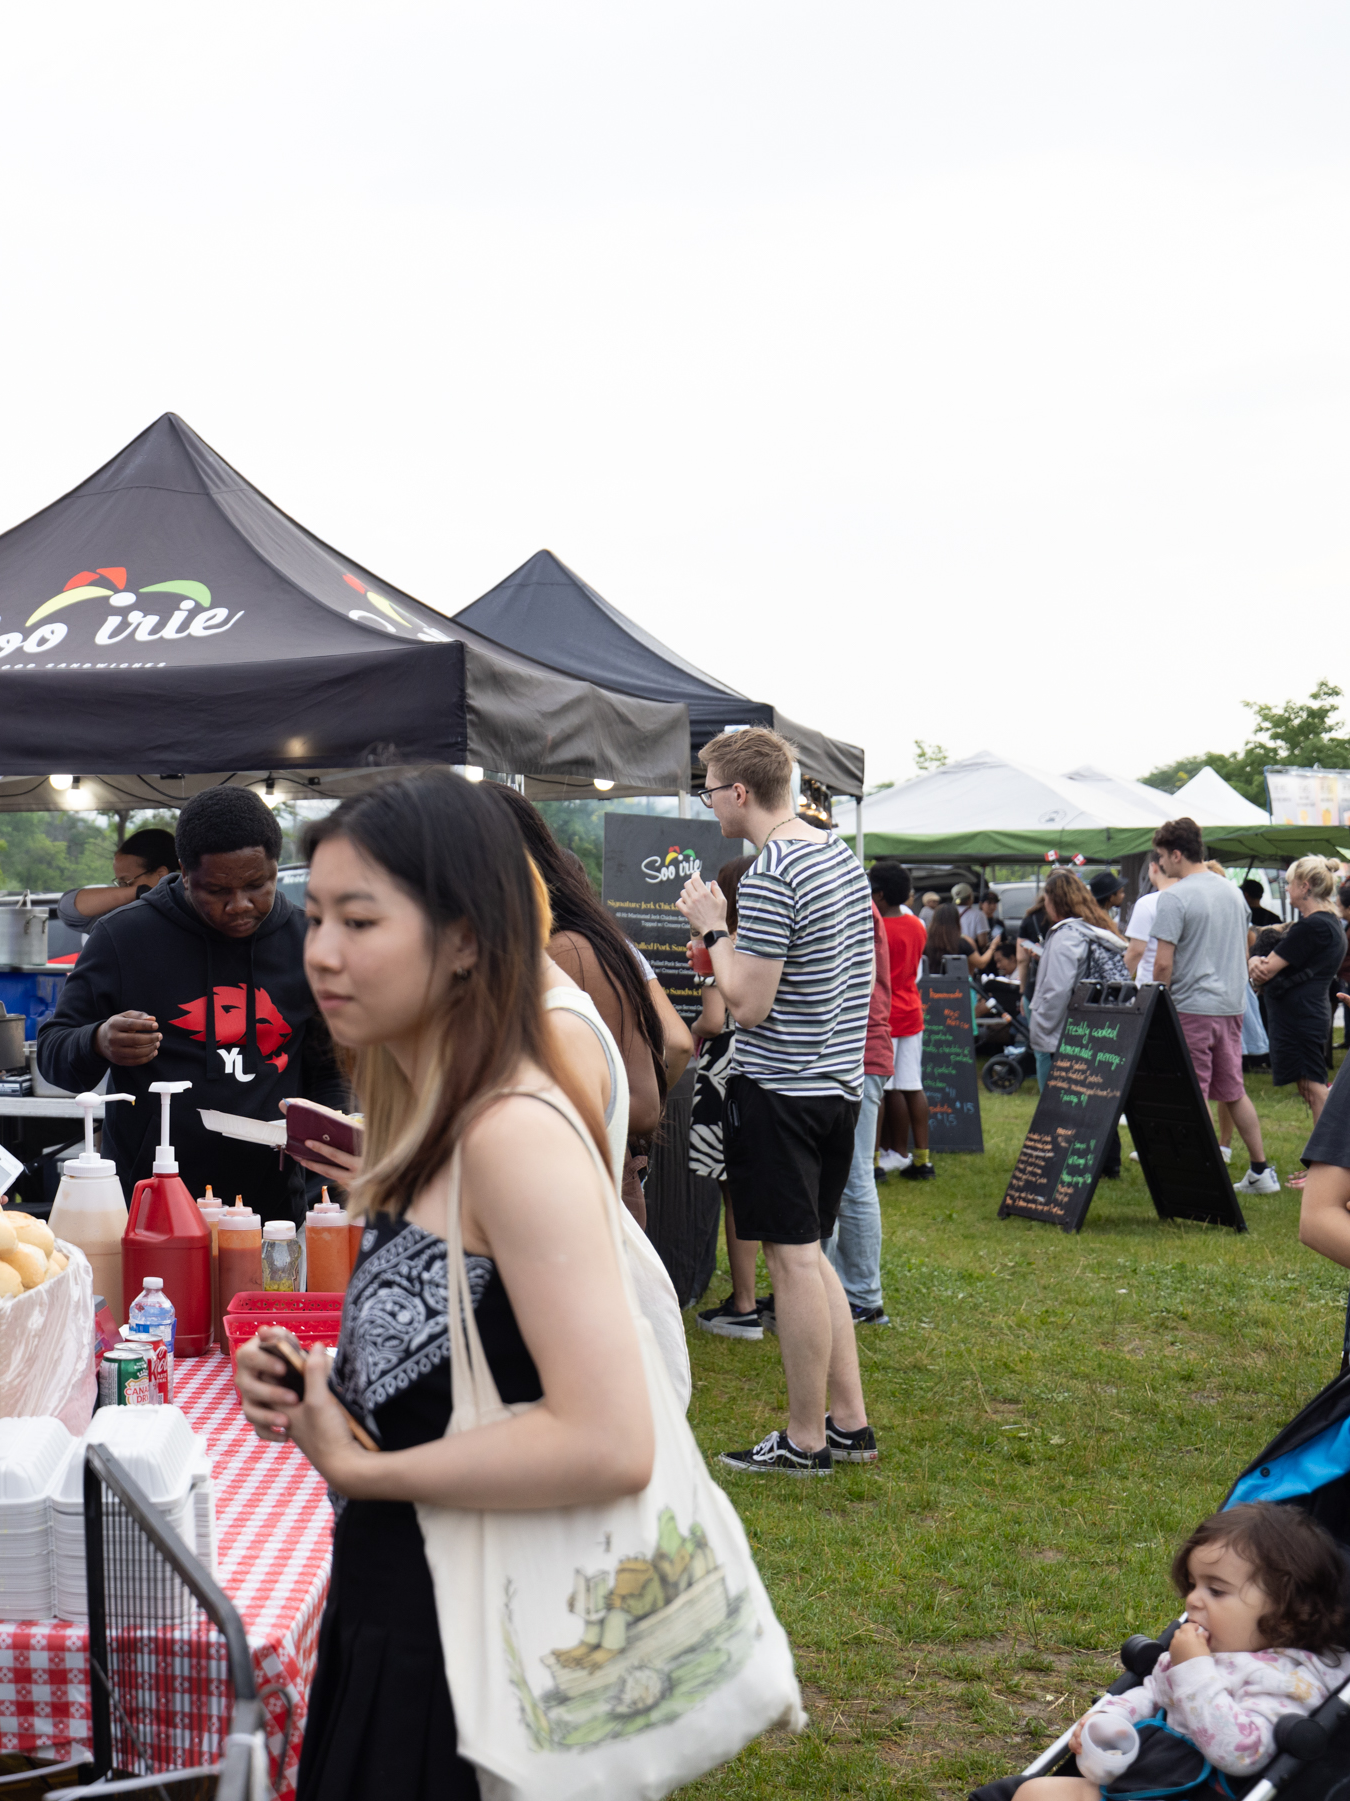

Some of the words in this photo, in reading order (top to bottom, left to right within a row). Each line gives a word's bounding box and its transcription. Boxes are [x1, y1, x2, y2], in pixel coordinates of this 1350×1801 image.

[641, 855, 676, 884] Soo
[677, 853, 703, 877] irie
[607, 899, 641, 909] Signature
[641, 901, 655, 910] Jerk
[654, 943, 671, 951] Pork
[1064, 1018, 1091, 1044] Freshly
[1091, 1021, 1120, 1040] cooked
[124, 1385, 149, 1397] CANA
